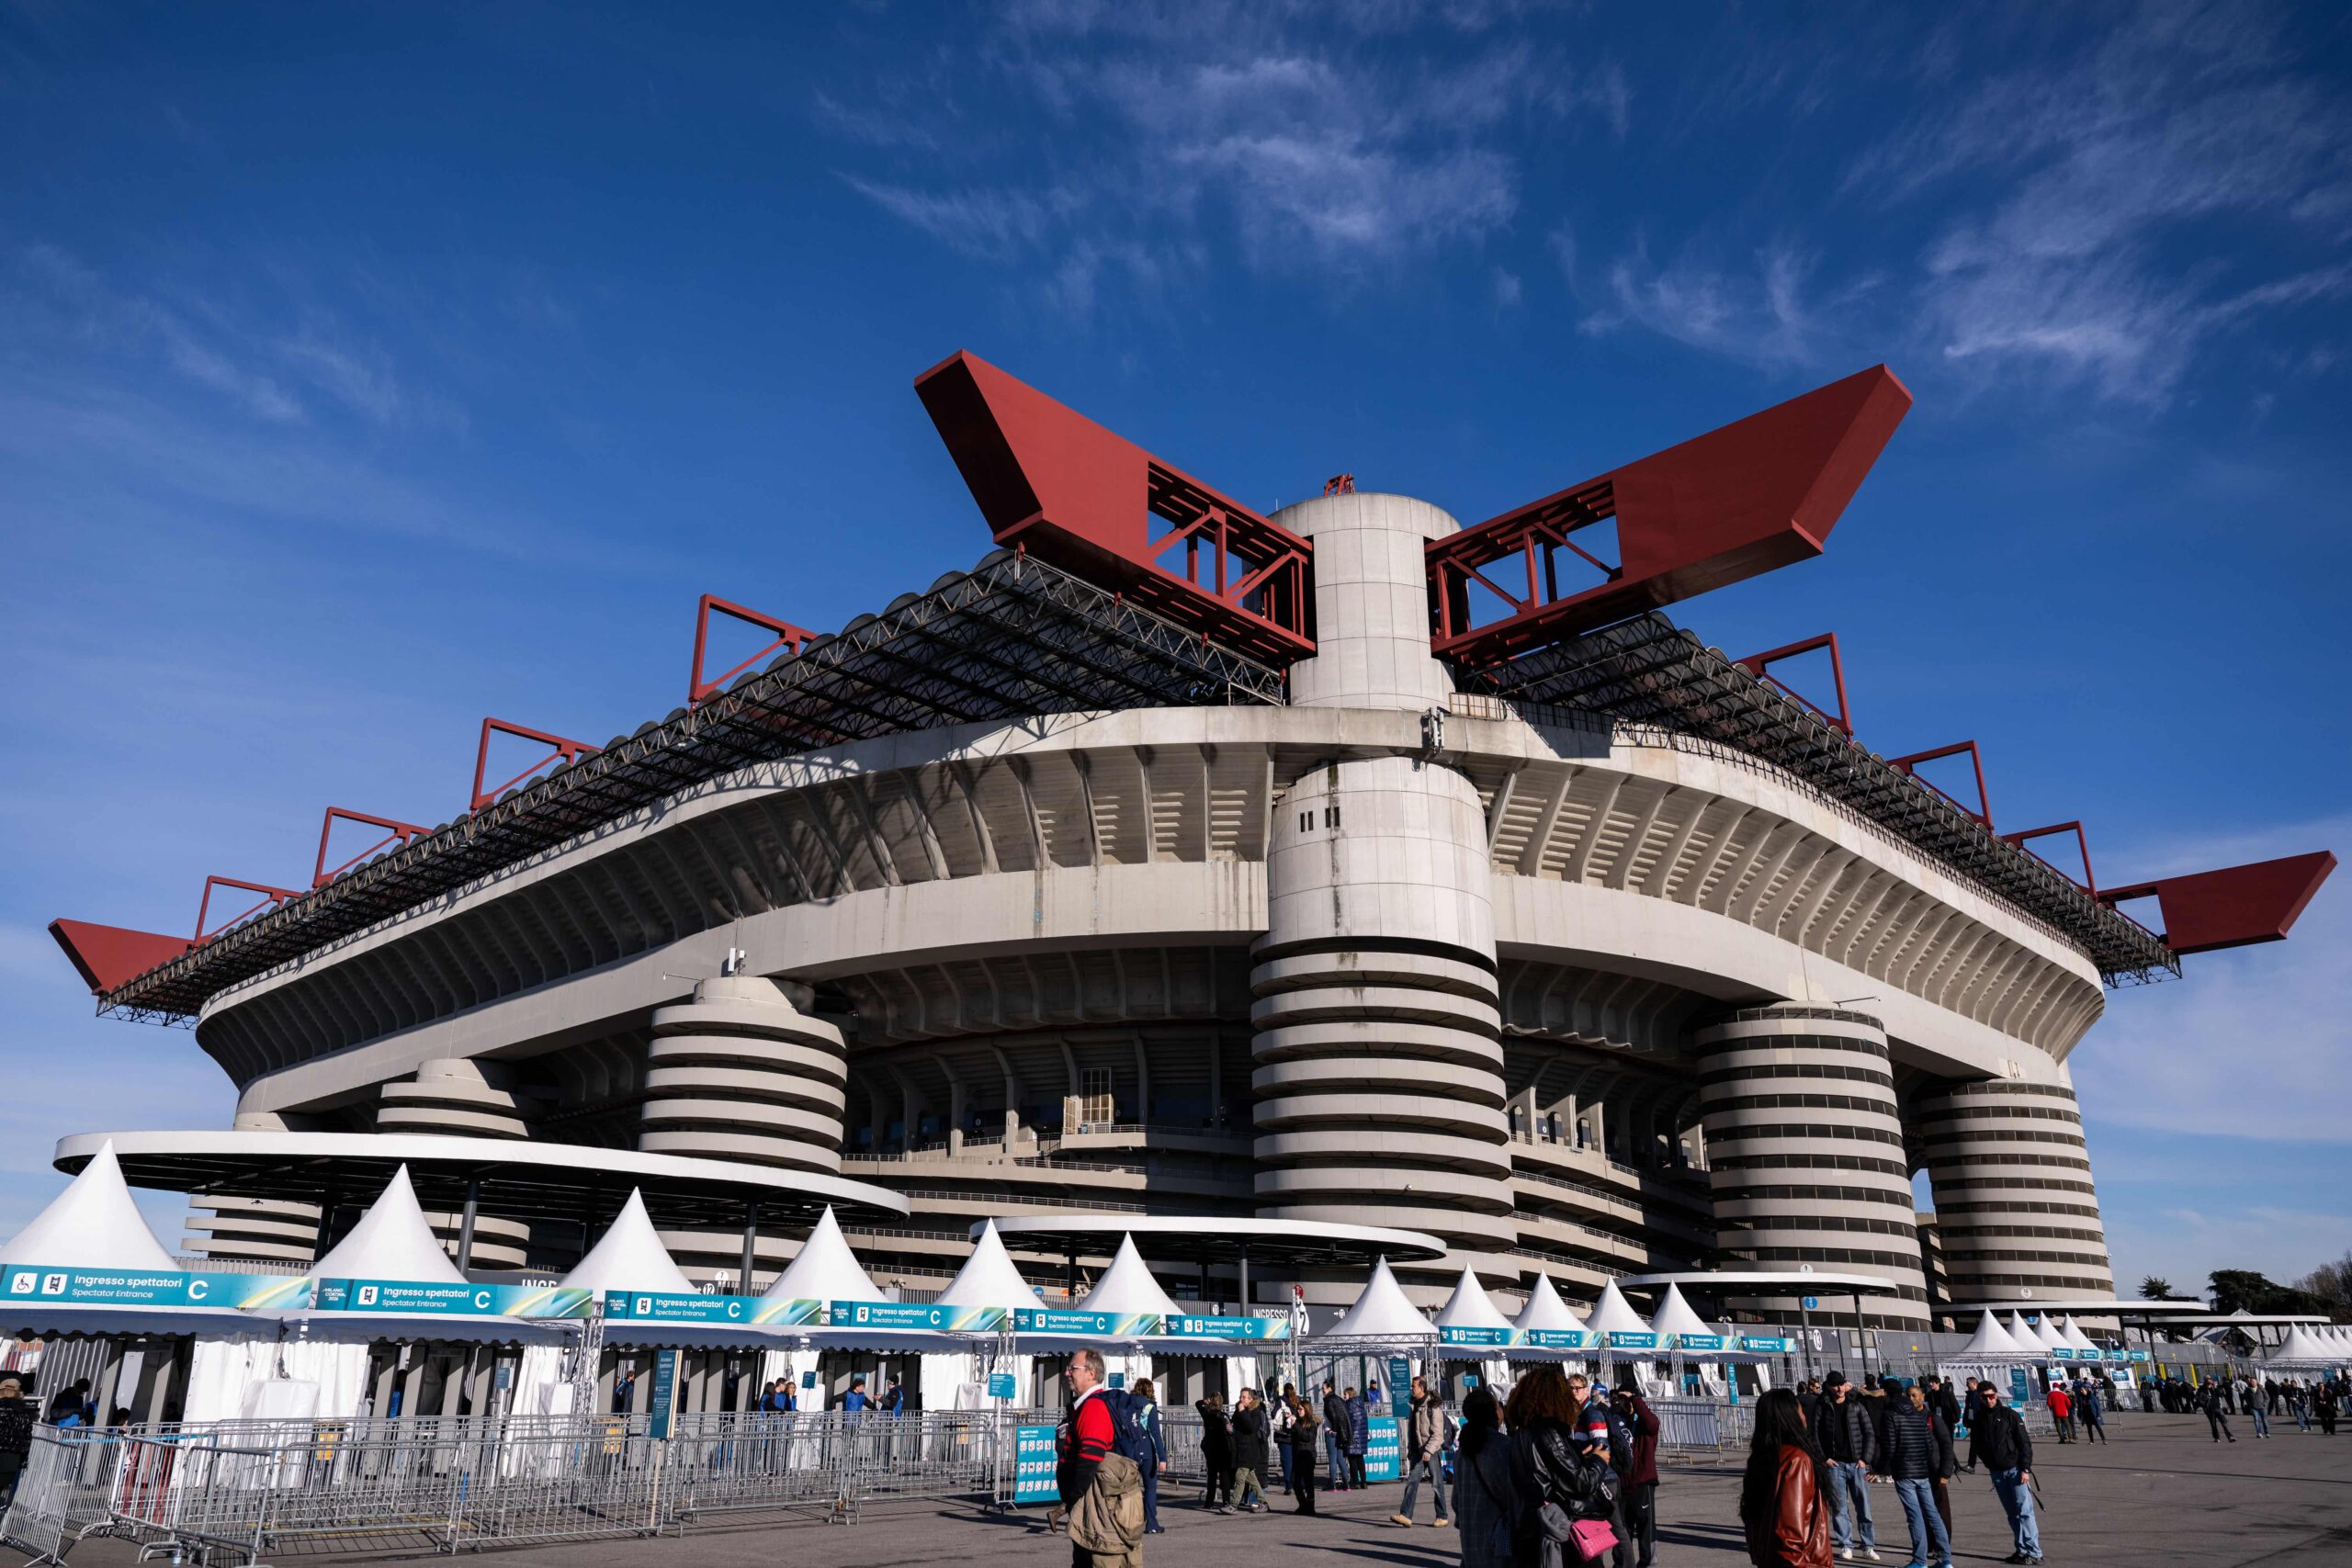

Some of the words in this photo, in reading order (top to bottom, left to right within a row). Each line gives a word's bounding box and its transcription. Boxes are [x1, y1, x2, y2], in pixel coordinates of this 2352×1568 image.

[74, 1275, 125, 1287] Ingresso
[126, 1278, 182, 1289] spettatori
[188, 1280, 209, 1300] C
[705, 1284, 714, 1295] 12
[72, 1289, 114, 1297] Spectator
[116, 1290, 153, 1299] Entrance
[384, 1287, 424, 1298] Ingresso
[425, 1290, 469, 1300] spettatori
[475, 1291, 491, 1309] C
[382, 1299, 415, 1307] Spectator
[656, 1298, 687, 1308] Ingresso
[688, 1301, 724, 1309] spettatori
[728, 1302, 741, 1318] C
[872, 1307, 898, 1316] Ingresso
[898, 1309, 927, 1317] spettatori
[930, 1310, 941, 1325] C
[1252, 1308, 1288, 1320] INGRESSO
[1096, 1316, 1105, 1330] C
[1244, 1322, 1252, 1335] C
[1495, 1331, 1501, 1342] C
[1571, 1334, 1577, 1344] C
[1646, 1336, 1652, 1346] C
